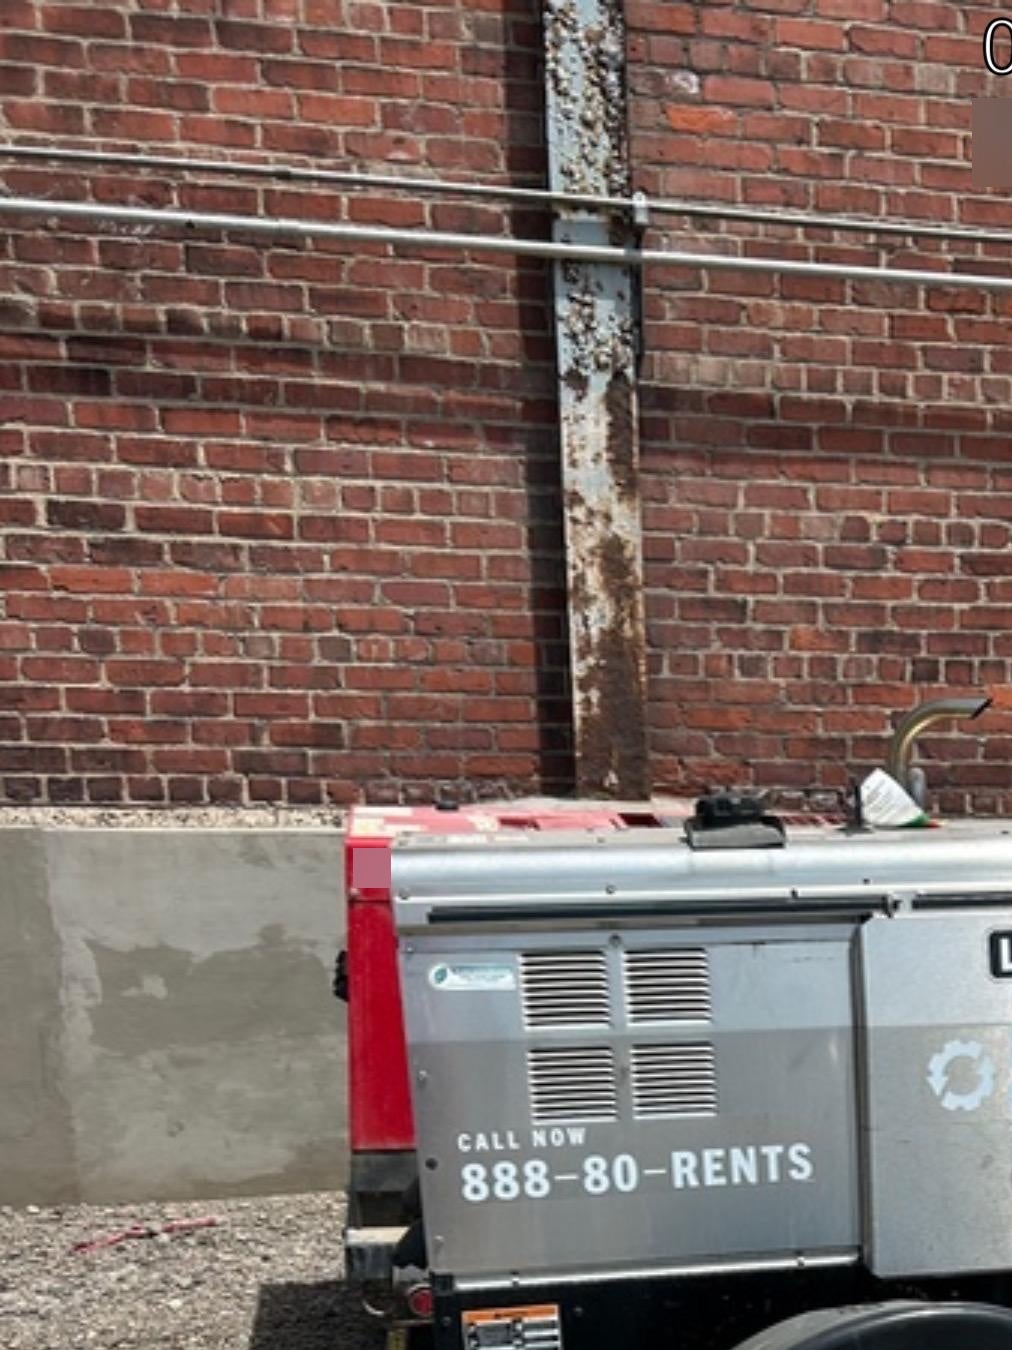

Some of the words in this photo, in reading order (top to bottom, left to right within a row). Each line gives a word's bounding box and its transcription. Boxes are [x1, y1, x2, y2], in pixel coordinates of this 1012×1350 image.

[458, 1130, 521, 1152] CALL
[531, 1127, 587, 1148] NOW
[461, 1142, 814, 1202] 888-80-RENTS
